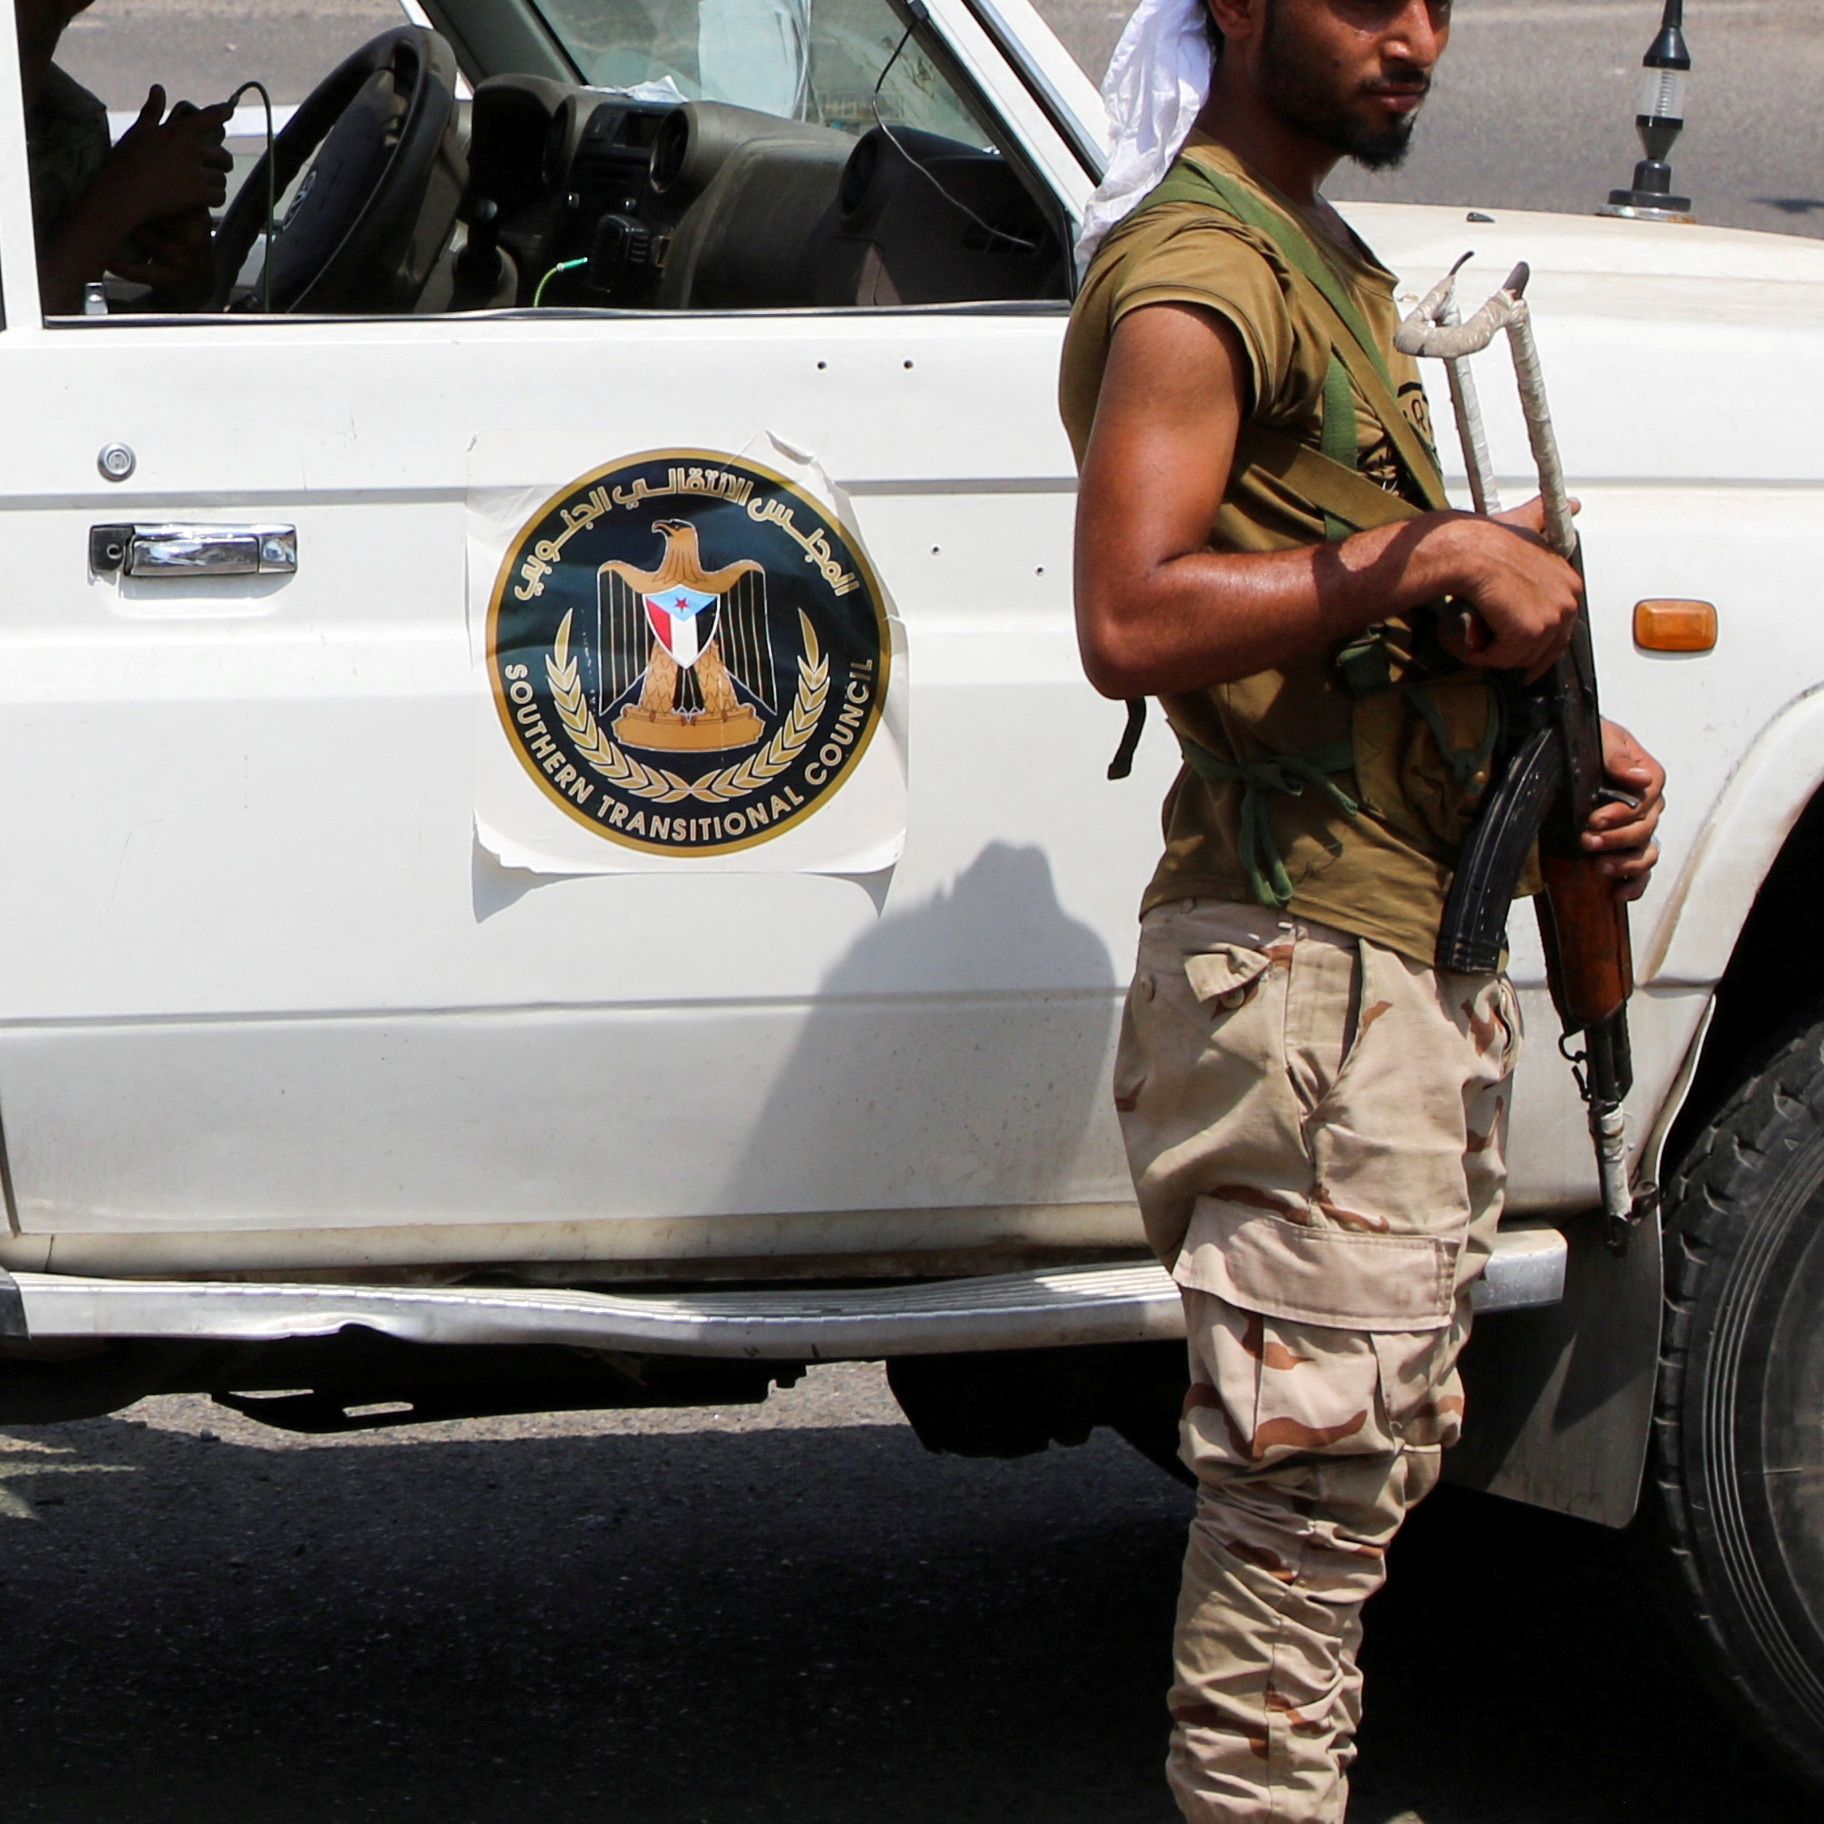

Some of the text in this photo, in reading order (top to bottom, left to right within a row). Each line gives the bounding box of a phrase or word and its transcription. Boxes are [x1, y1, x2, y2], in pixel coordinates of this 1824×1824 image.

[513, 466, 861, 602] المجلس الانتقالي الجنوبي
[504, 657, 874, 842] SOUTHERN TRANSITIONAL COUNCIL
